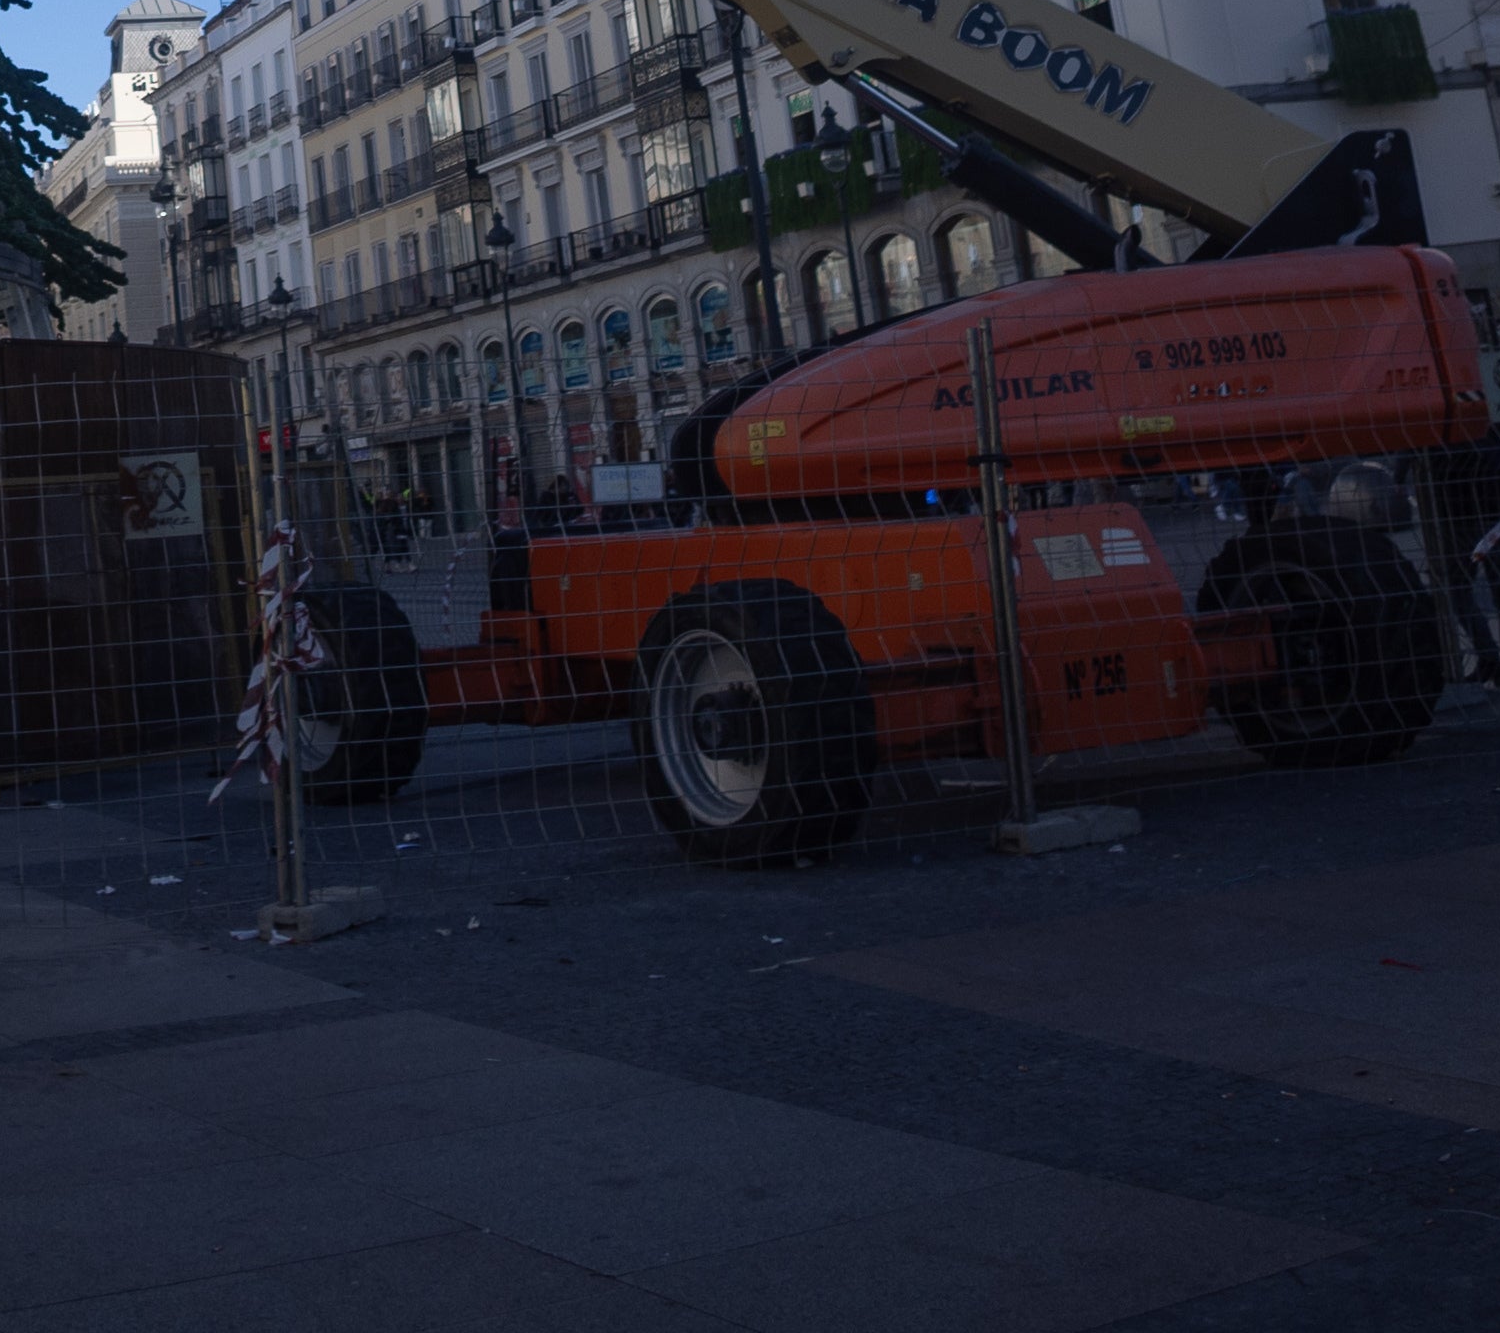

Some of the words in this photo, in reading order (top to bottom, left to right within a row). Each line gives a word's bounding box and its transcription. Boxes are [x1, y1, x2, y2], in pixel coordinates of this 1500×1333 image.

[1165, 340, 1205, 368] 902
[1208, 336, 1246, 365] 999
[1251, 332, 1287, 359] 103
[1092, 653, 1128, 696] 256
